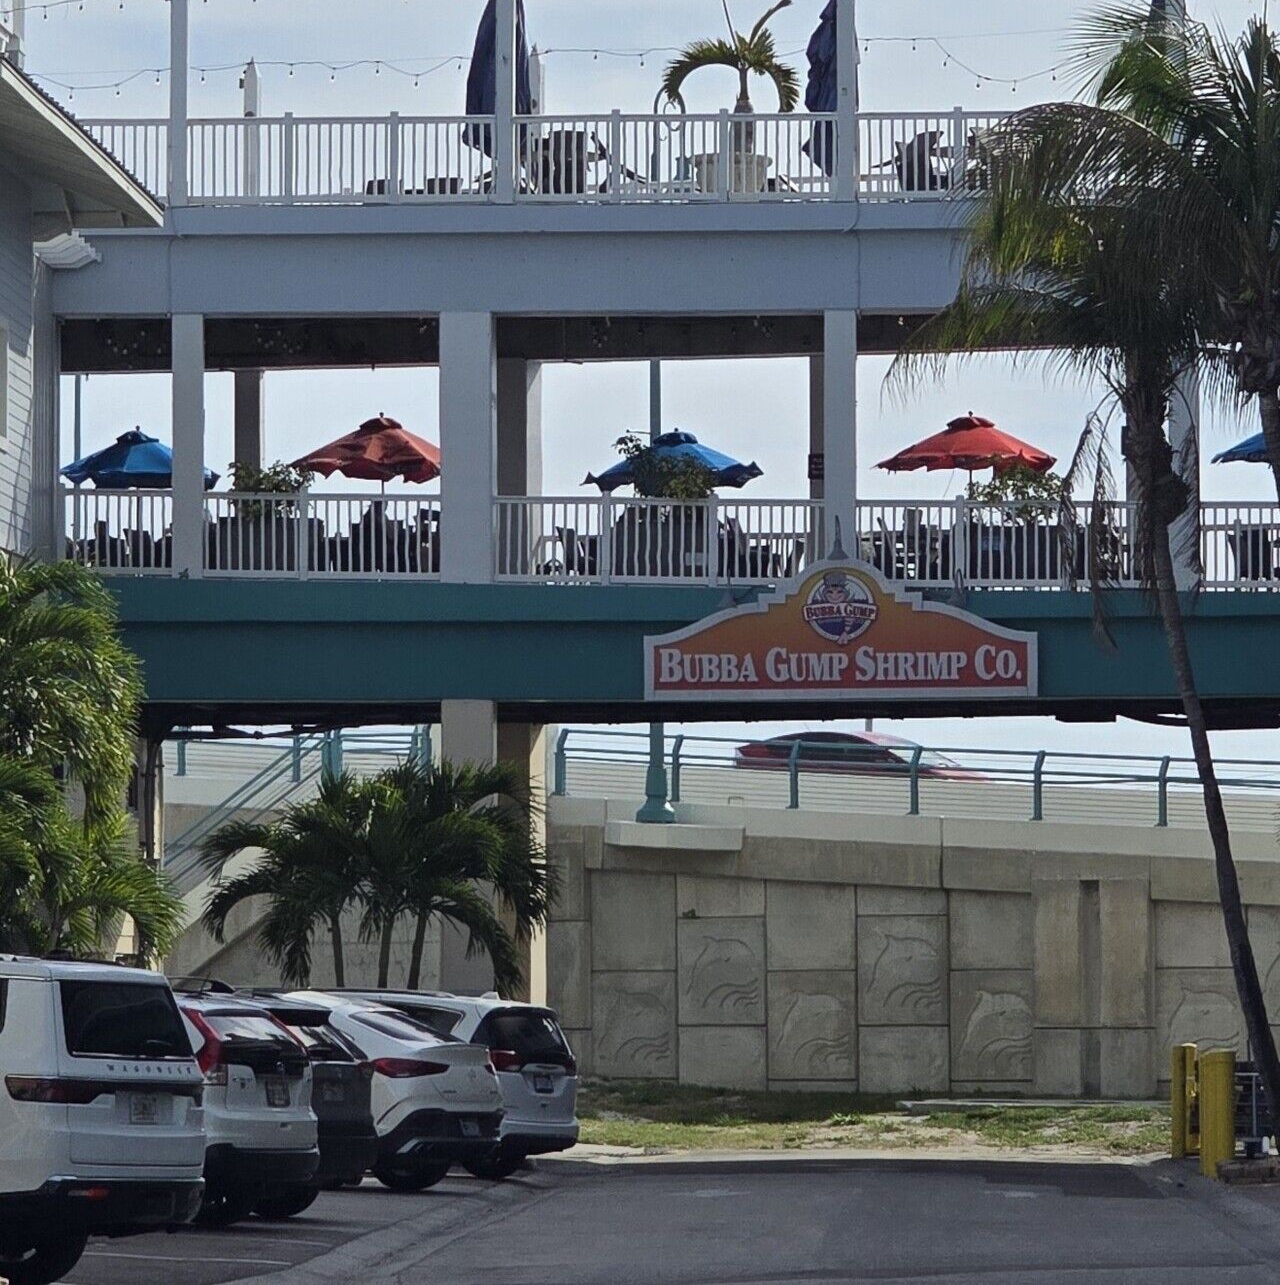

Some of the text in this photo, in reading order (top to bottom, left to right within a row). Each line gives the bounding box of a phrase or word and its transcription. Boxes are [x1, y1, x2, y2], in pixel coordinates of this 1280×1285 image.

[806, 604, 875, 619] BUBBA GUMP
[659, 645, 1023, 684] BUBBA GUMP SHRIMP CO.
